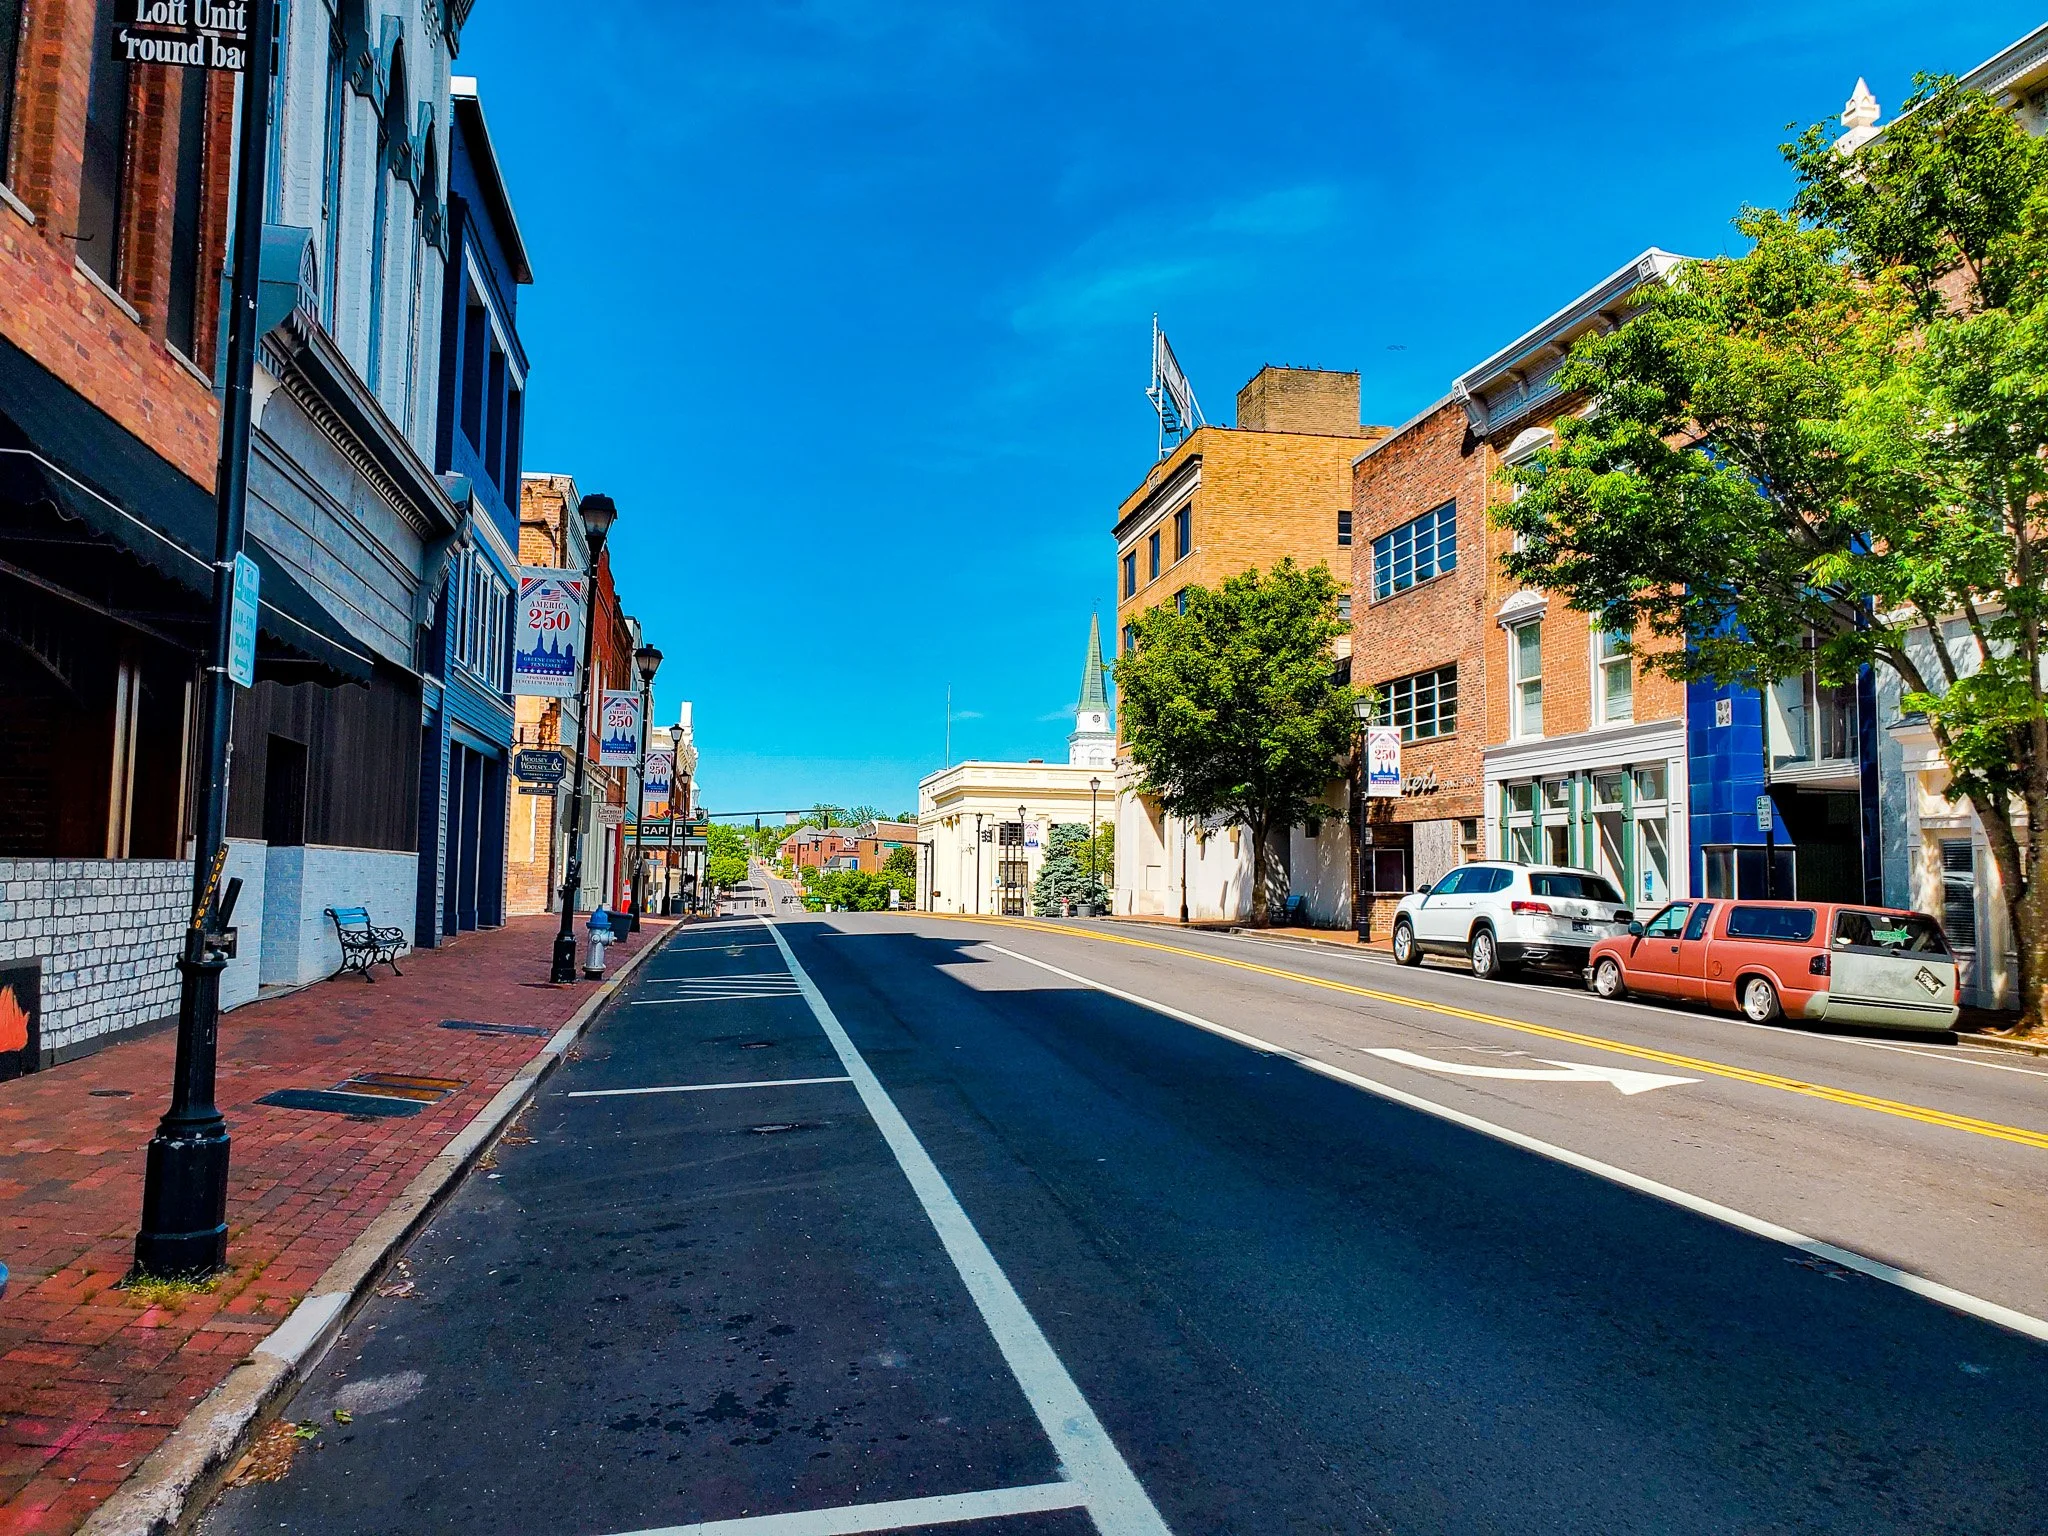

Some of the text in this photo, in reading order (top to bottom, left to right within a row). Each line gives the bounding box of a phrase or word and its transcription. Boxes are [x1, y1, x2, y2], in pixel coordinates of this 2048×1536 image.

[136, 0, 188, 26] Loft
[211, 37, 246, 70] ba
[530, 600, 569, 609] AMERICA
[528, 608, 571, 632] 250
[608, 714, 633, 728] 250
[1374, 749, 1396, 760] 250
[649, 765, 667, 775] 250
[642, 825, 690, 835] CAPIOL
